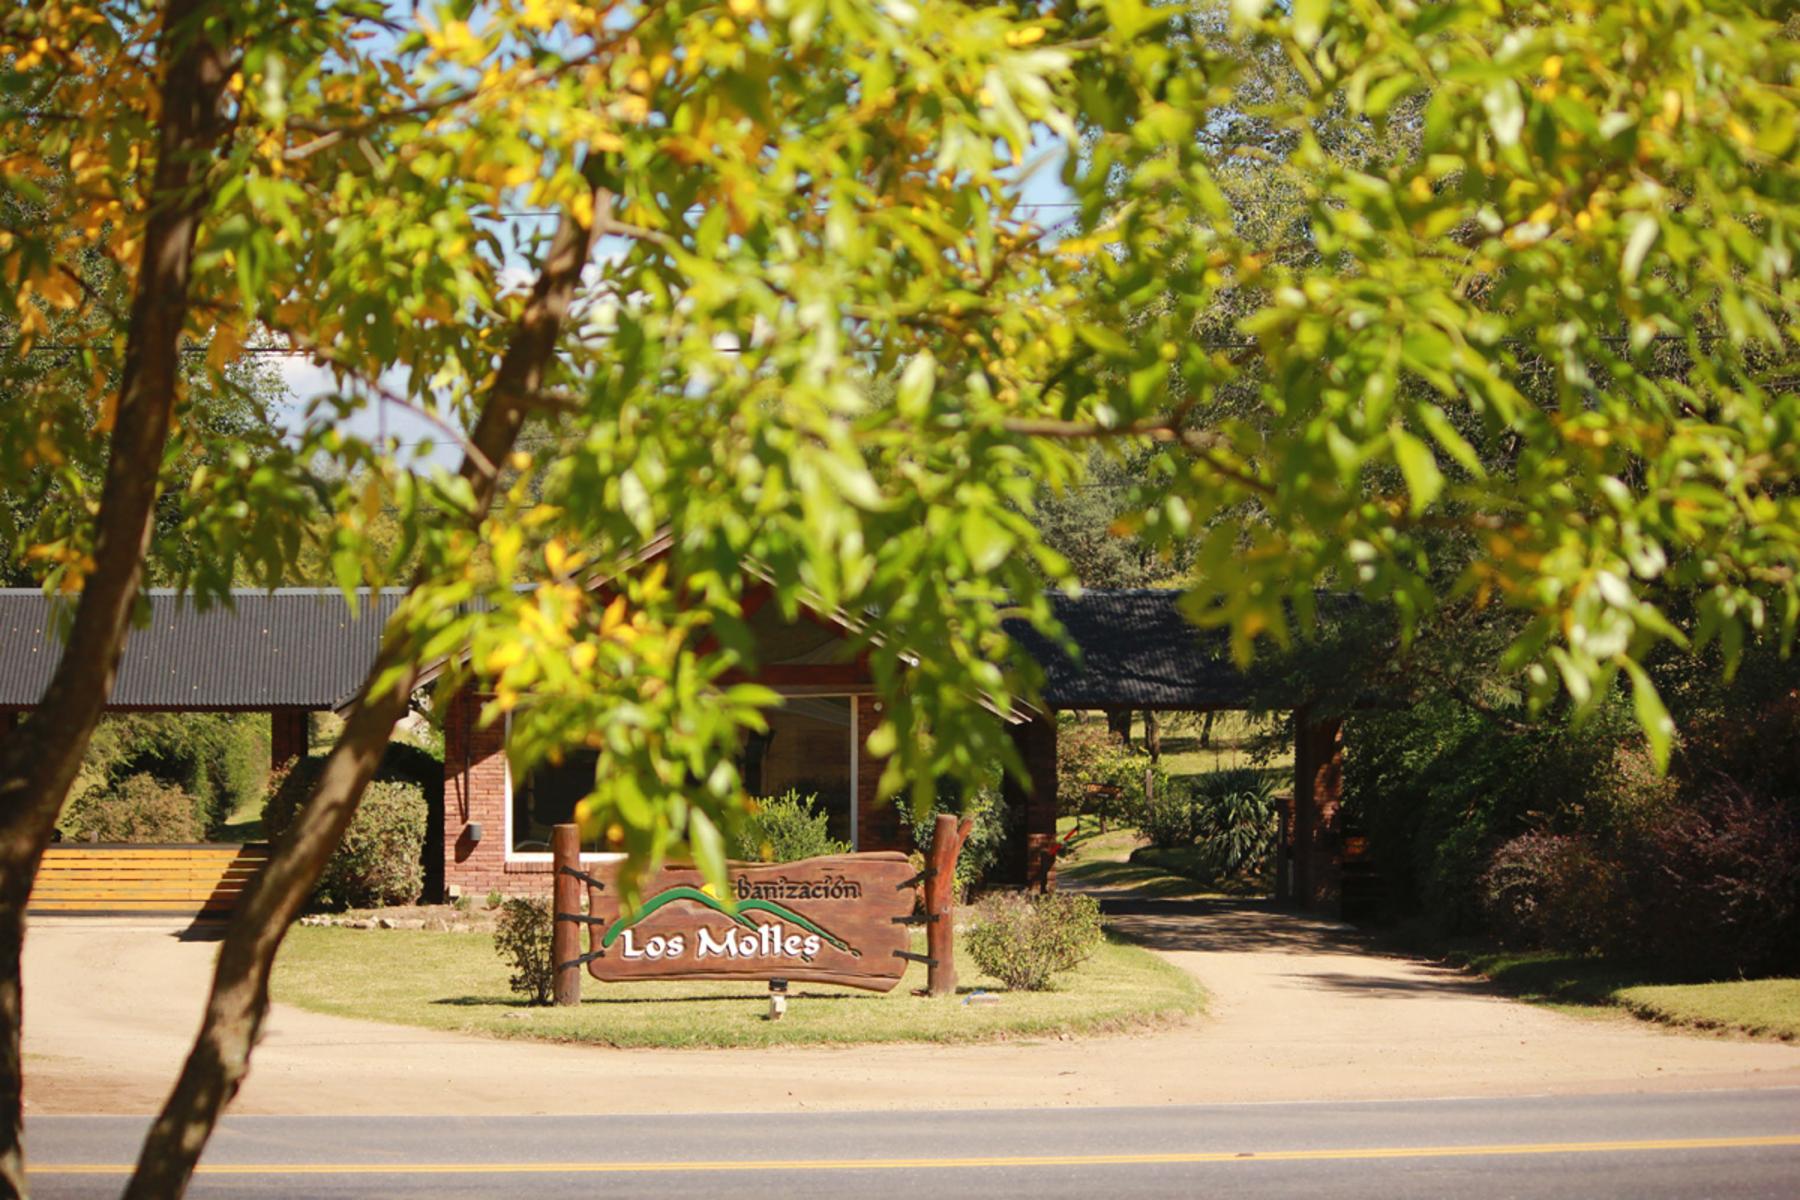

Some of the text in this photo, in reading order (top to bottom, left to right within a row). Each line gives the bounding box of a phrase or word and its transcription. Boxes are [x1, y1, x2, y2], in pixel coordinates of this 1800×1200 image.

[720, 873, 862, 899] banización
[621, 922, 822, 959] Los Molles
